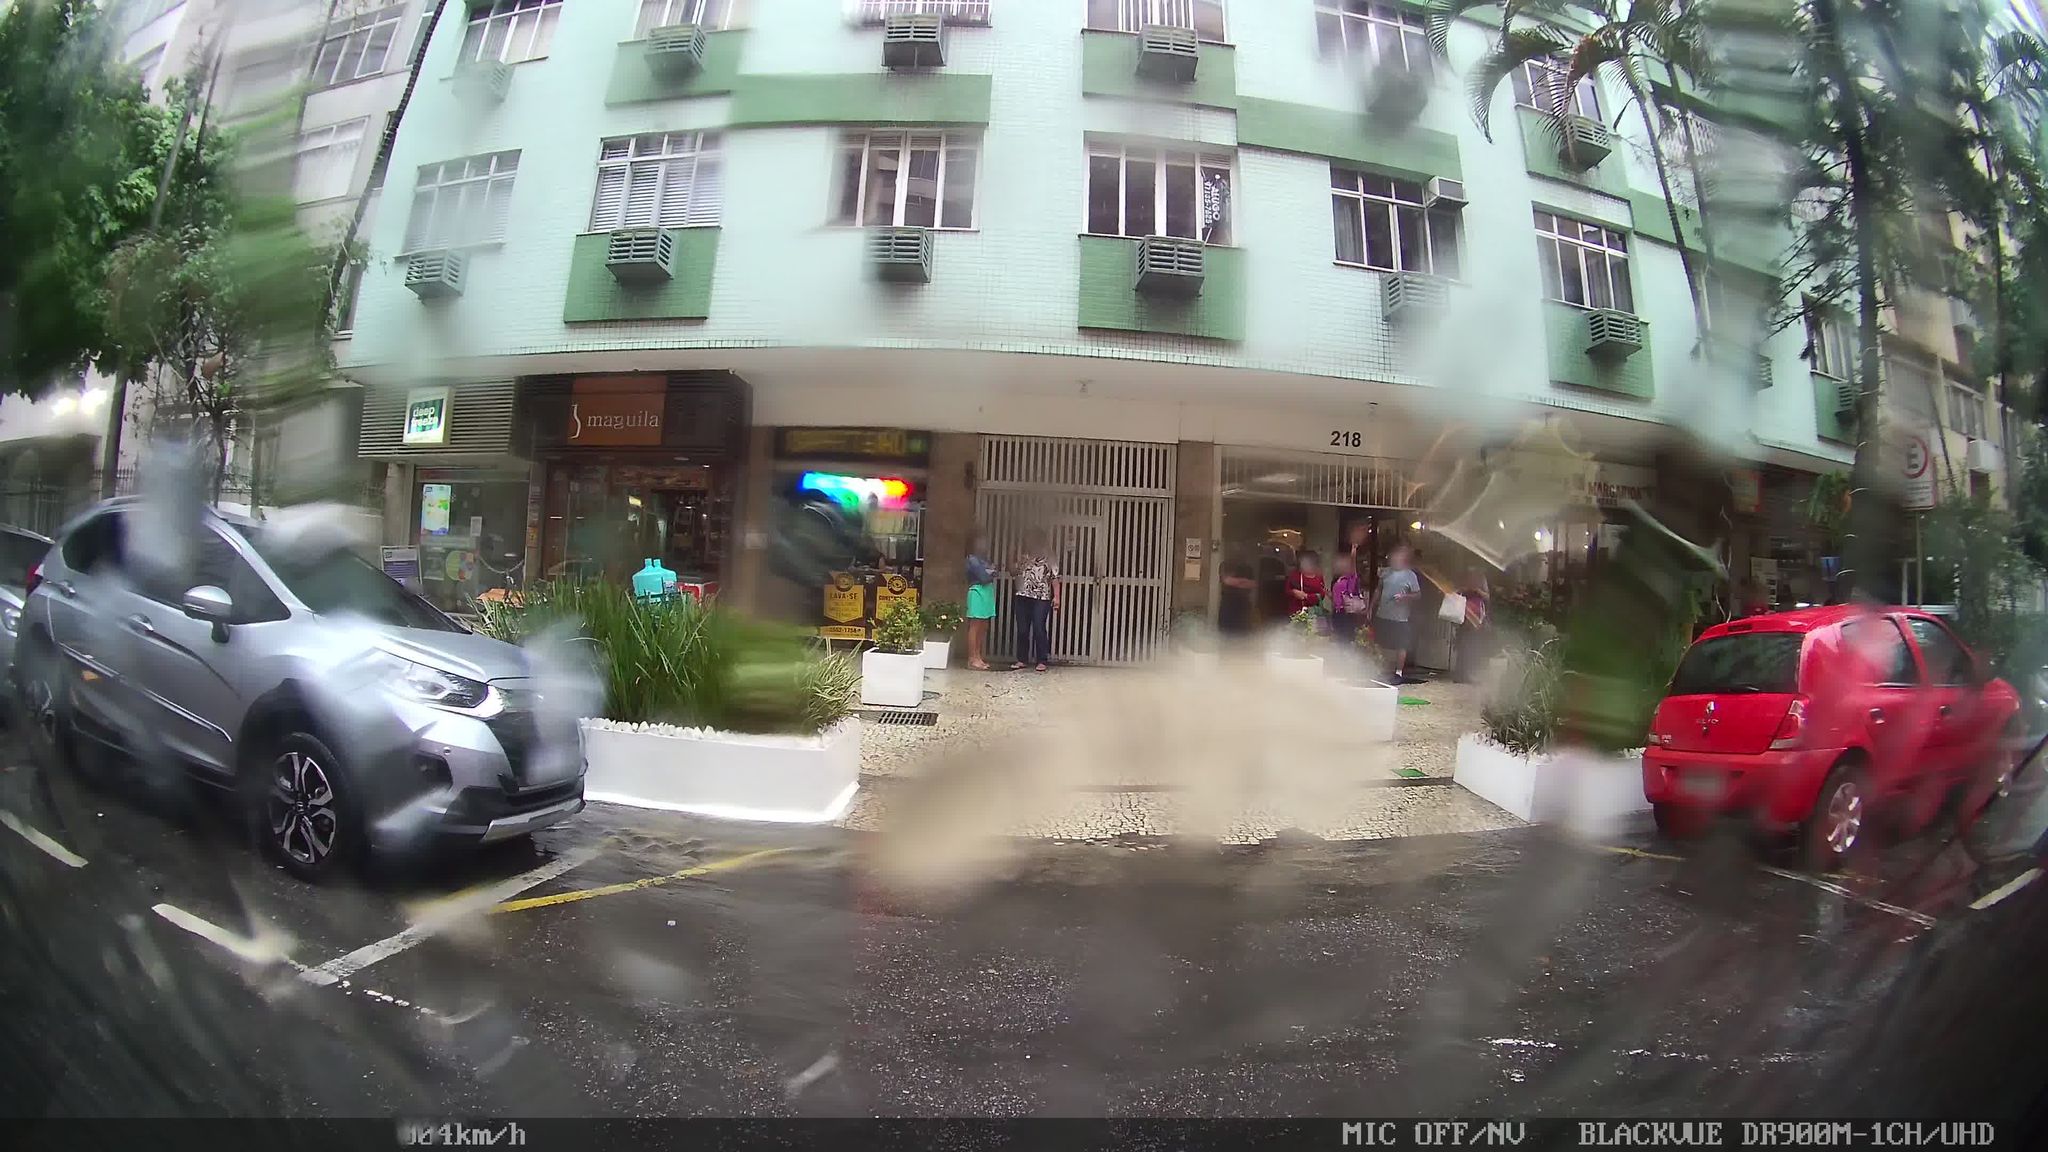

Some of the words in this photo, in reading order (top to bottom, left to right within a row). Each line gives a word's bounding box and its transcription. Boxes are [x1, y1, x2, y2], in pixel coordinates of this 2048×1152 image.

[1210, 186, 1221, 221] ALUGO
[412, 406, 435, 419] deep
[586, 410, 660, 430] maguila
[1330, 430, 1361, 448] 218
[830, 592, 858, 600] LAVA-SE
